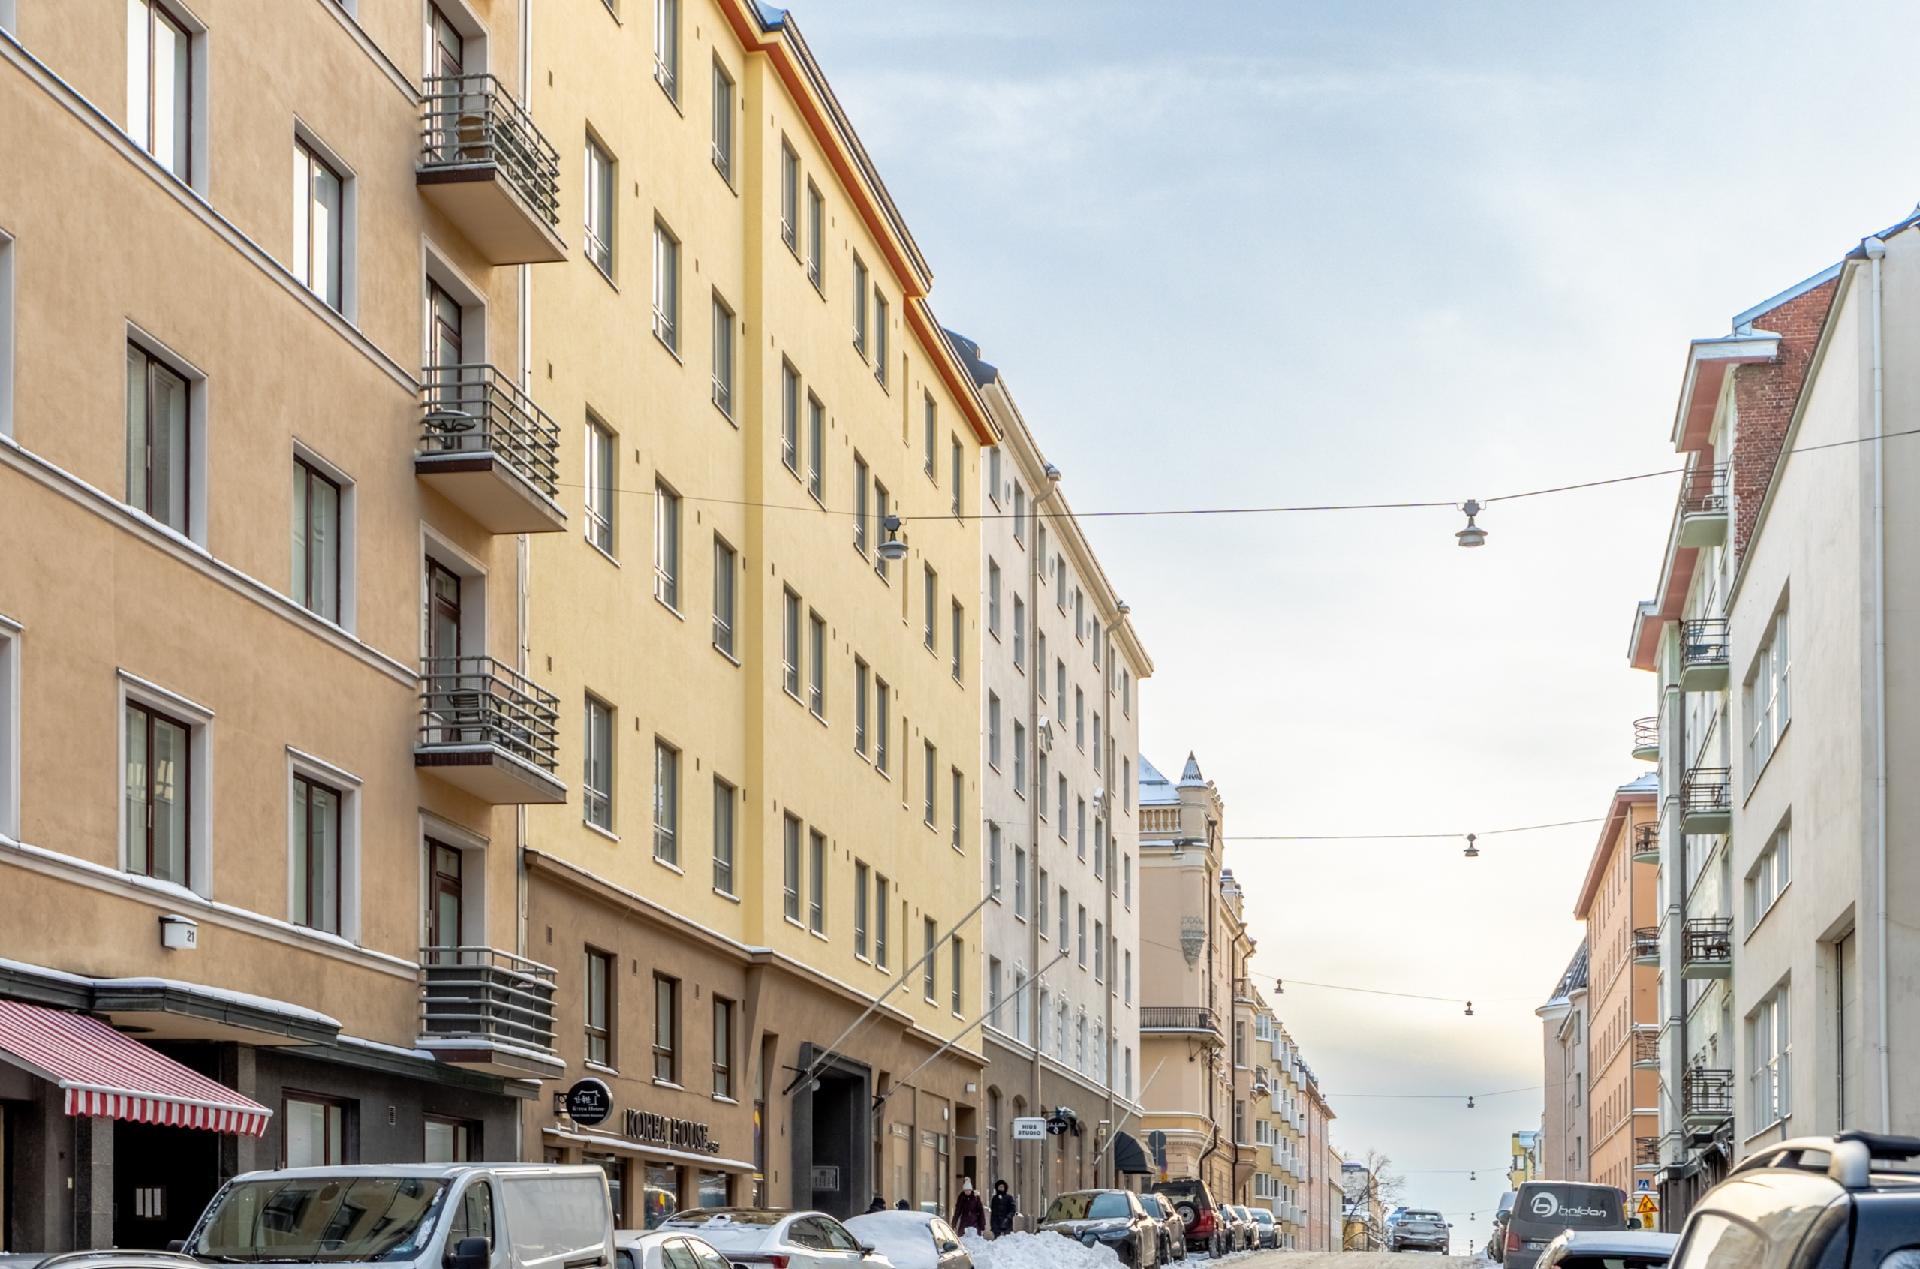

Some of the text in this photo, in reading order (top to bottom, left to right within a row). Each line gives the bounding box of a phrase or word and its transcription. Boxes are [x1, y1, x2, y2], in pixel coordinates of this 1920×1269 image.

[187, 930, 194, 943] 21
[624, 1108, 667, 1142] KOREA
[667, 1116, 708, 1150] HOUSE
